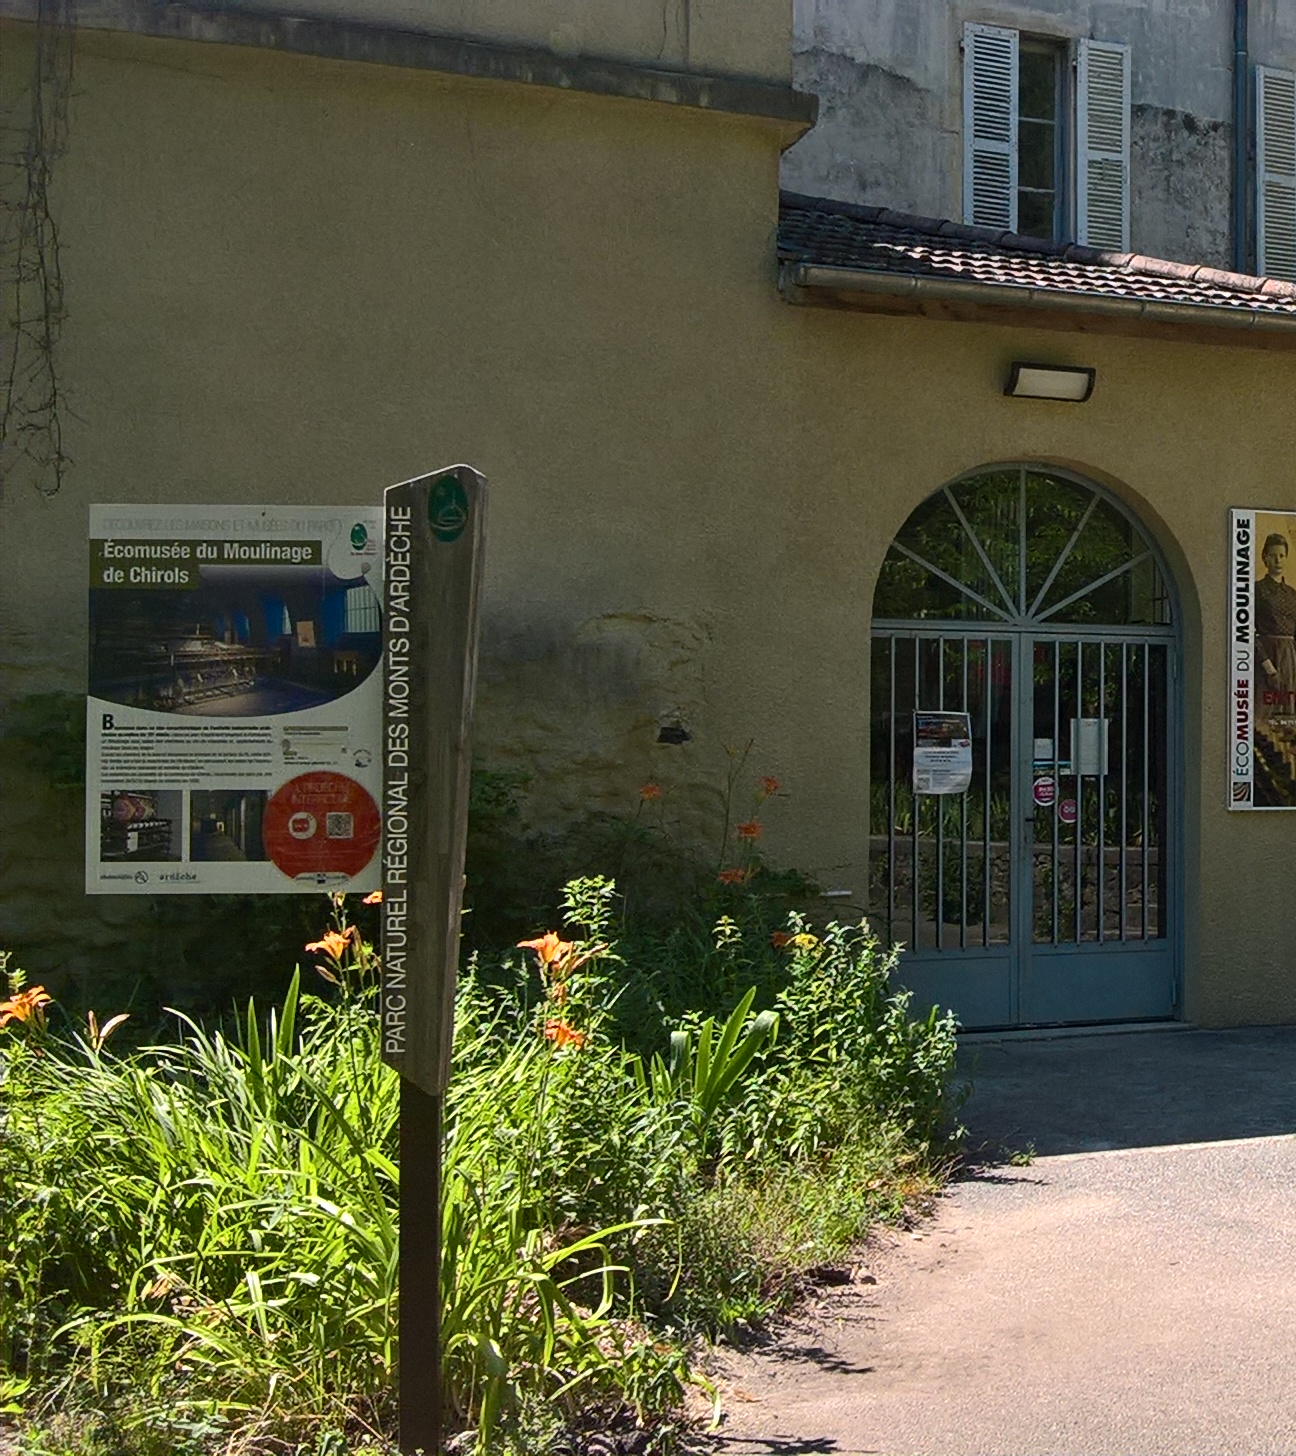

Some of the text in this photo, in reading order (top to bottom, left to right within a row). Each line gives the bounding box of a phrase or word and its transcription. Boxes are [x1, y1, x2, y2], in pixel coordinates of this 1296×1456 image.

[103, 539, 313, 563] Écomusée du Moulinage
[103, 567, 189, 583] de Chirols
[1232, 518, 1250, 776] ÉCOMUSÉE DU MOULINAGE
[383, 506, 411, 1053] PARC NATUREL RÉGIONAL DES MONTS D'ARDÈCHE
